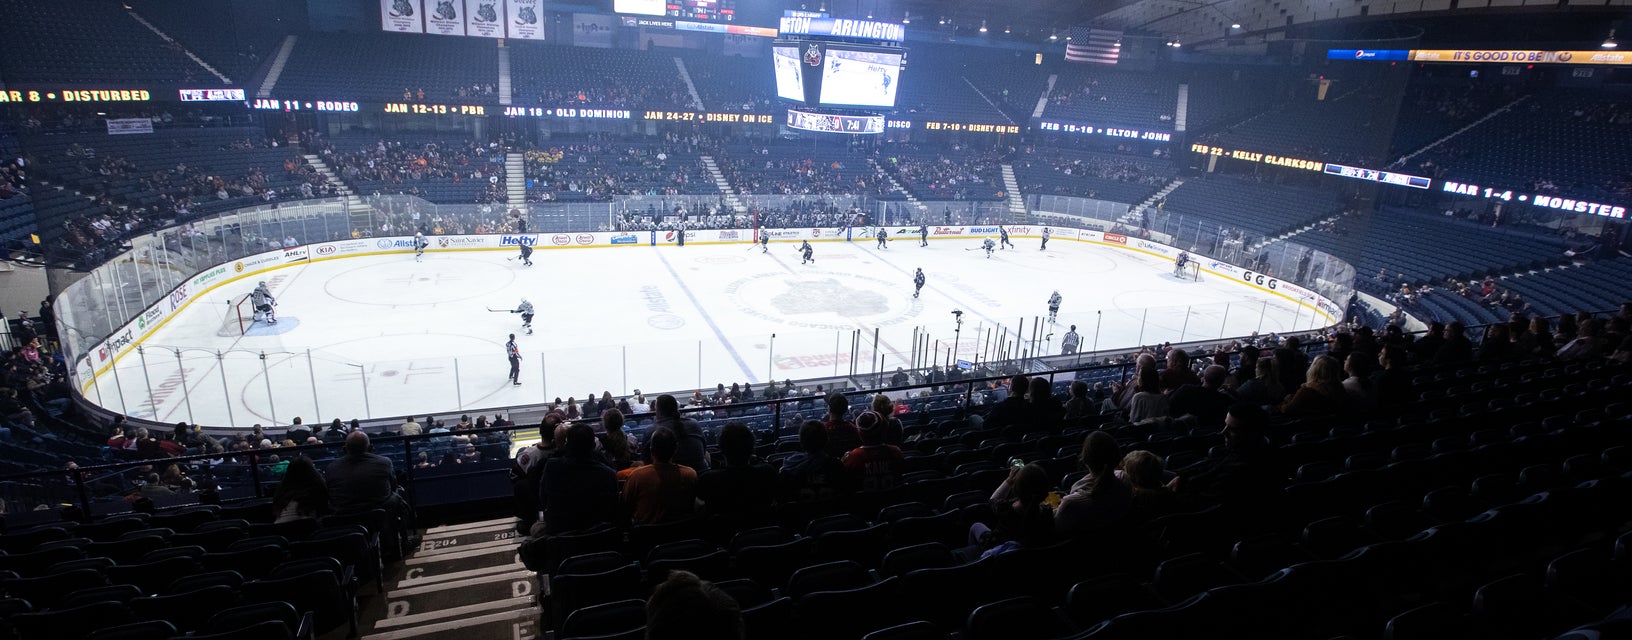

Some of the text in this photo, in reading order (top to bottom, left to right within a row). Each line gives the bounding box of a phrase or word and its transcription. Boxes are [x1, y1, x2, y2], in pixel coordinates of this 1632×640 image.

[830, 19, 900, 41] ARLINGTON
[1453, 52, 1558, 62] IT'S GOOD TO BE IN
[1590, 53, 1625, 62] Allstate
[28, 90, 41, 102] 8
[62, 90, 151, 102] DISTURBED
[253, 99, 359, 112] JAN 11 RODEO
[384, 103, 485, 116] JAN 12-13 PBR
[503, 106, 631, 120] JAN 18 OLD DOMINION
[643, 111, 773, 124] JAN 24-27 DISNEY ON ICE
[887, 120, 911, 130] DISCO
[926, 121, 1019, 135] FEB 7-10 DISNEY ON ICE
[1040, 121, 1060, 132] FEB
[1105, 127, 1139, 139] ELTON
[1140, 131, 1171, 143] JOHN
[1191, 143, 1209, 155] FEB
[1210, 146, 1224, 157] 22
[1232, 149, 1264, 164] KELLY
[1264, 155, 1324, 173] CLARKSON
[1442, 181, 1627, 220] MAR 1-4 MONSTER
[933, 226, 965, 236] Butternut
[1007, 226, 1031, 236] xfinity
[502, 236, 536, 247] Hefty
[1243, 271, 1278, 290] G G G
[169, 284, 188, 312] ROSE
[434, 538, 458, 548] 204
[494, 531, 516, 541] 203
[406, 567, 425, 580] C
[511, 580, 532, 598] D
[387, 600, 411, 619] D
